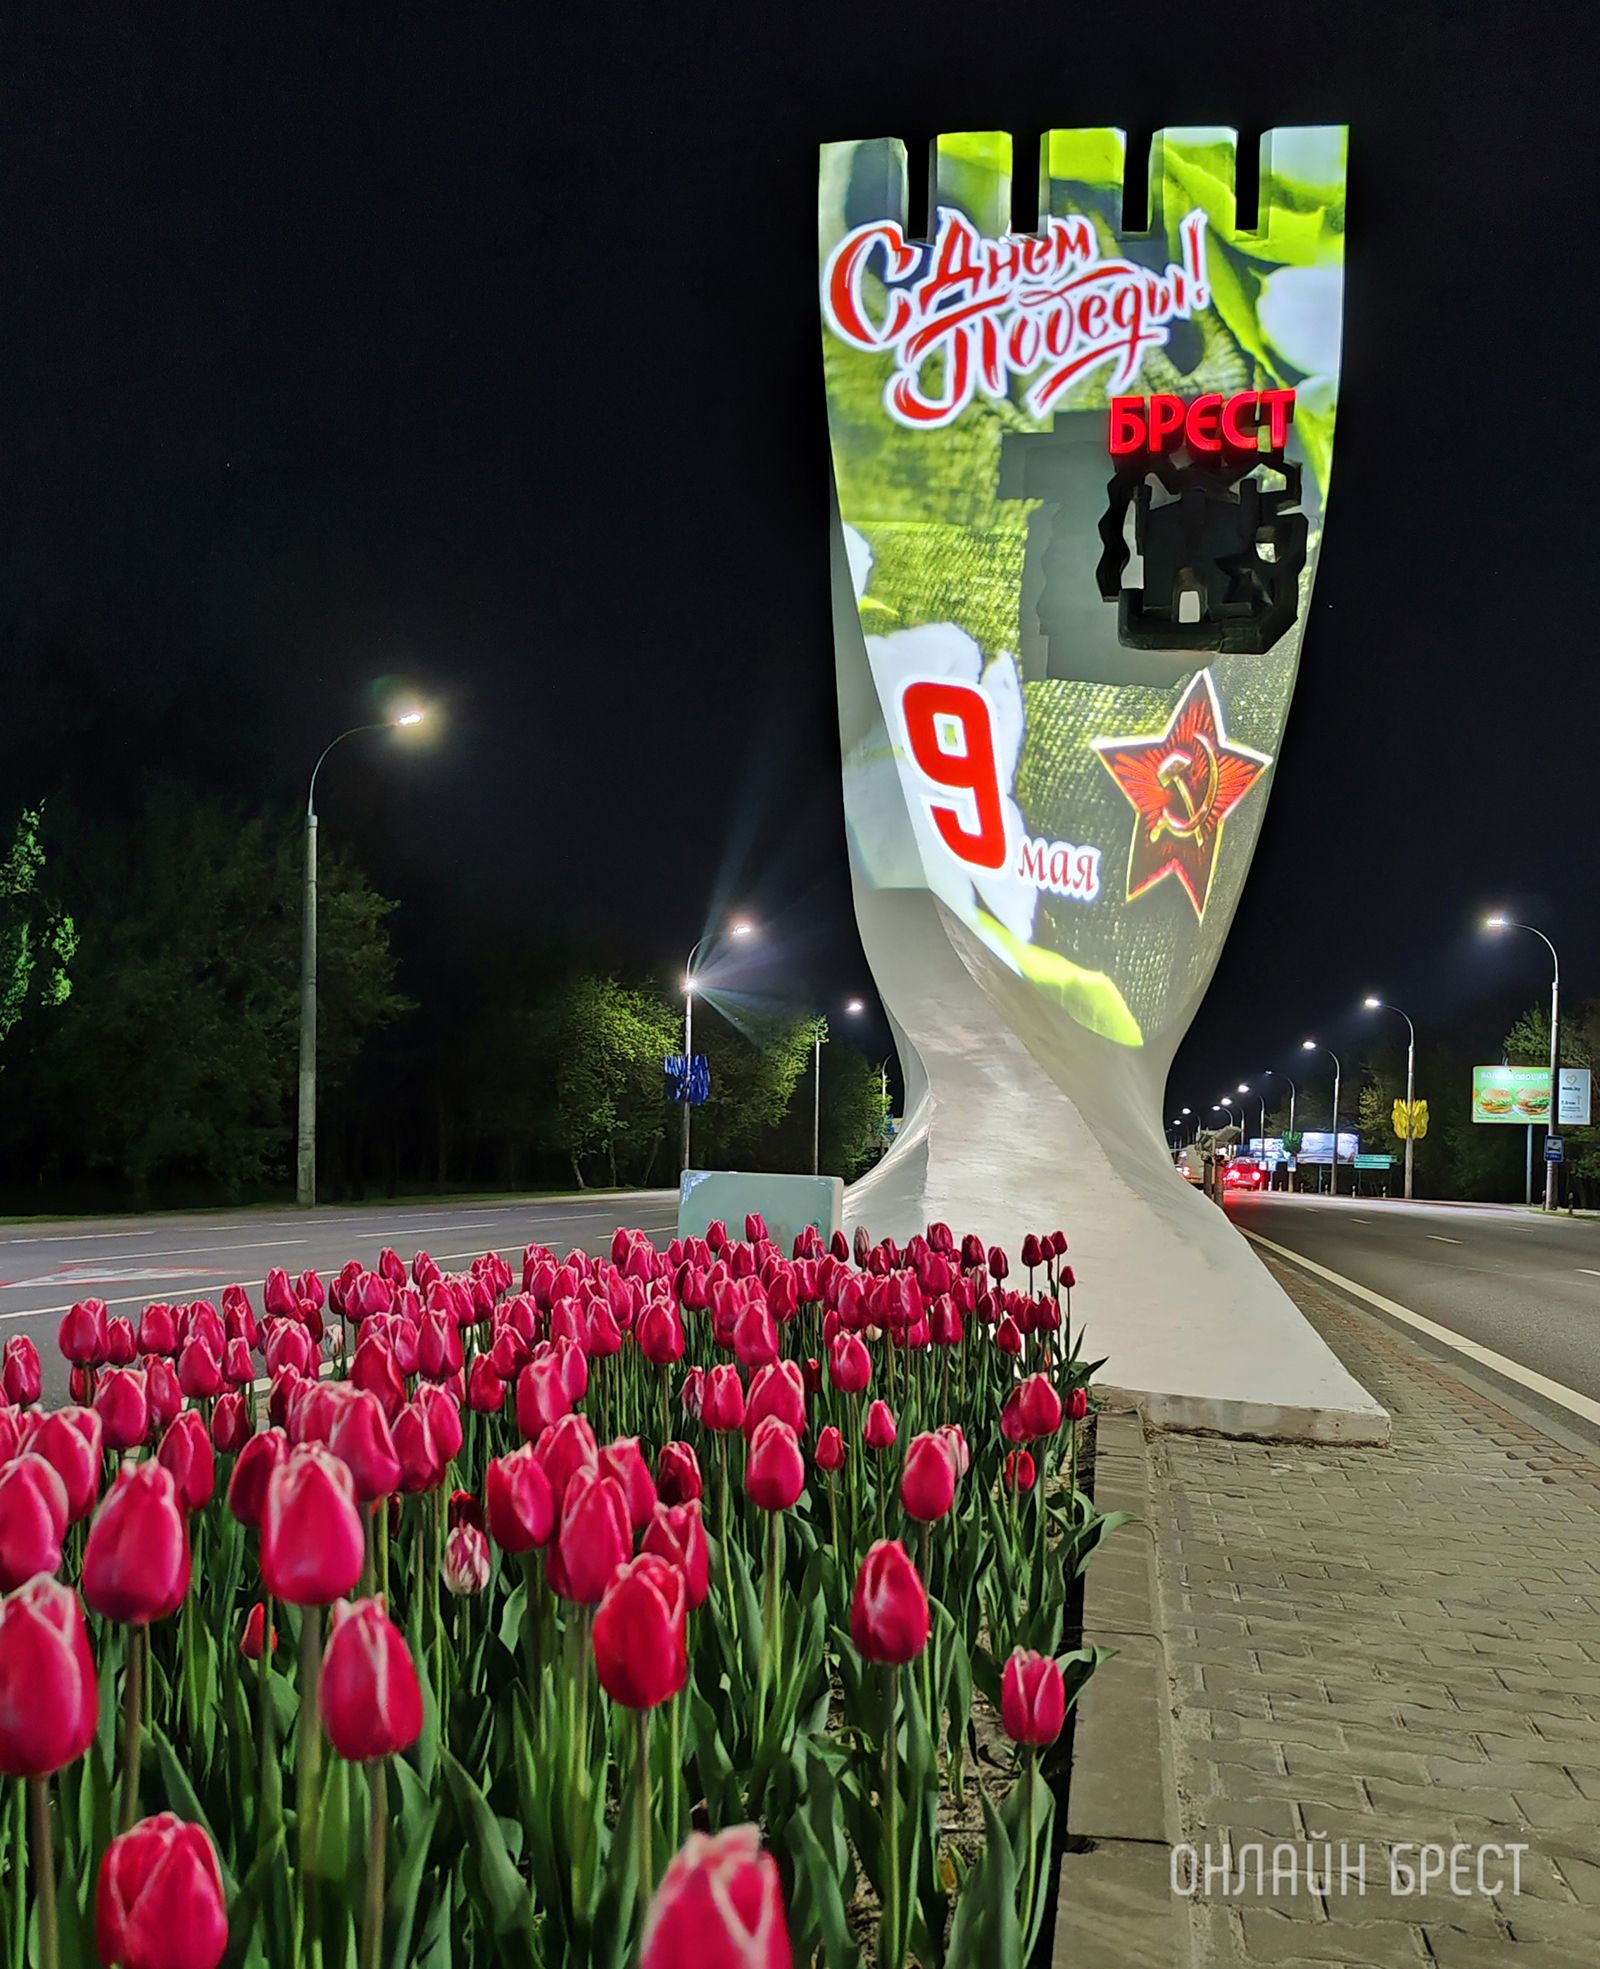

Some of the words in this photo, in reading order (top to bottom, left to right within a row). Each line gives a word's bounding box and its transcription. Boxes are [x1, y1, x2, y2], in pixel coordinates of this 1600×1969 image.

[828, 223, 914, 348] С
[892, 214, 1208, 422] Победы!
[1109, 389, 1296, 455] БРЕСТ
[902, 680, 1007, 870] 9
[1016, 842, 1101, 895] мая
